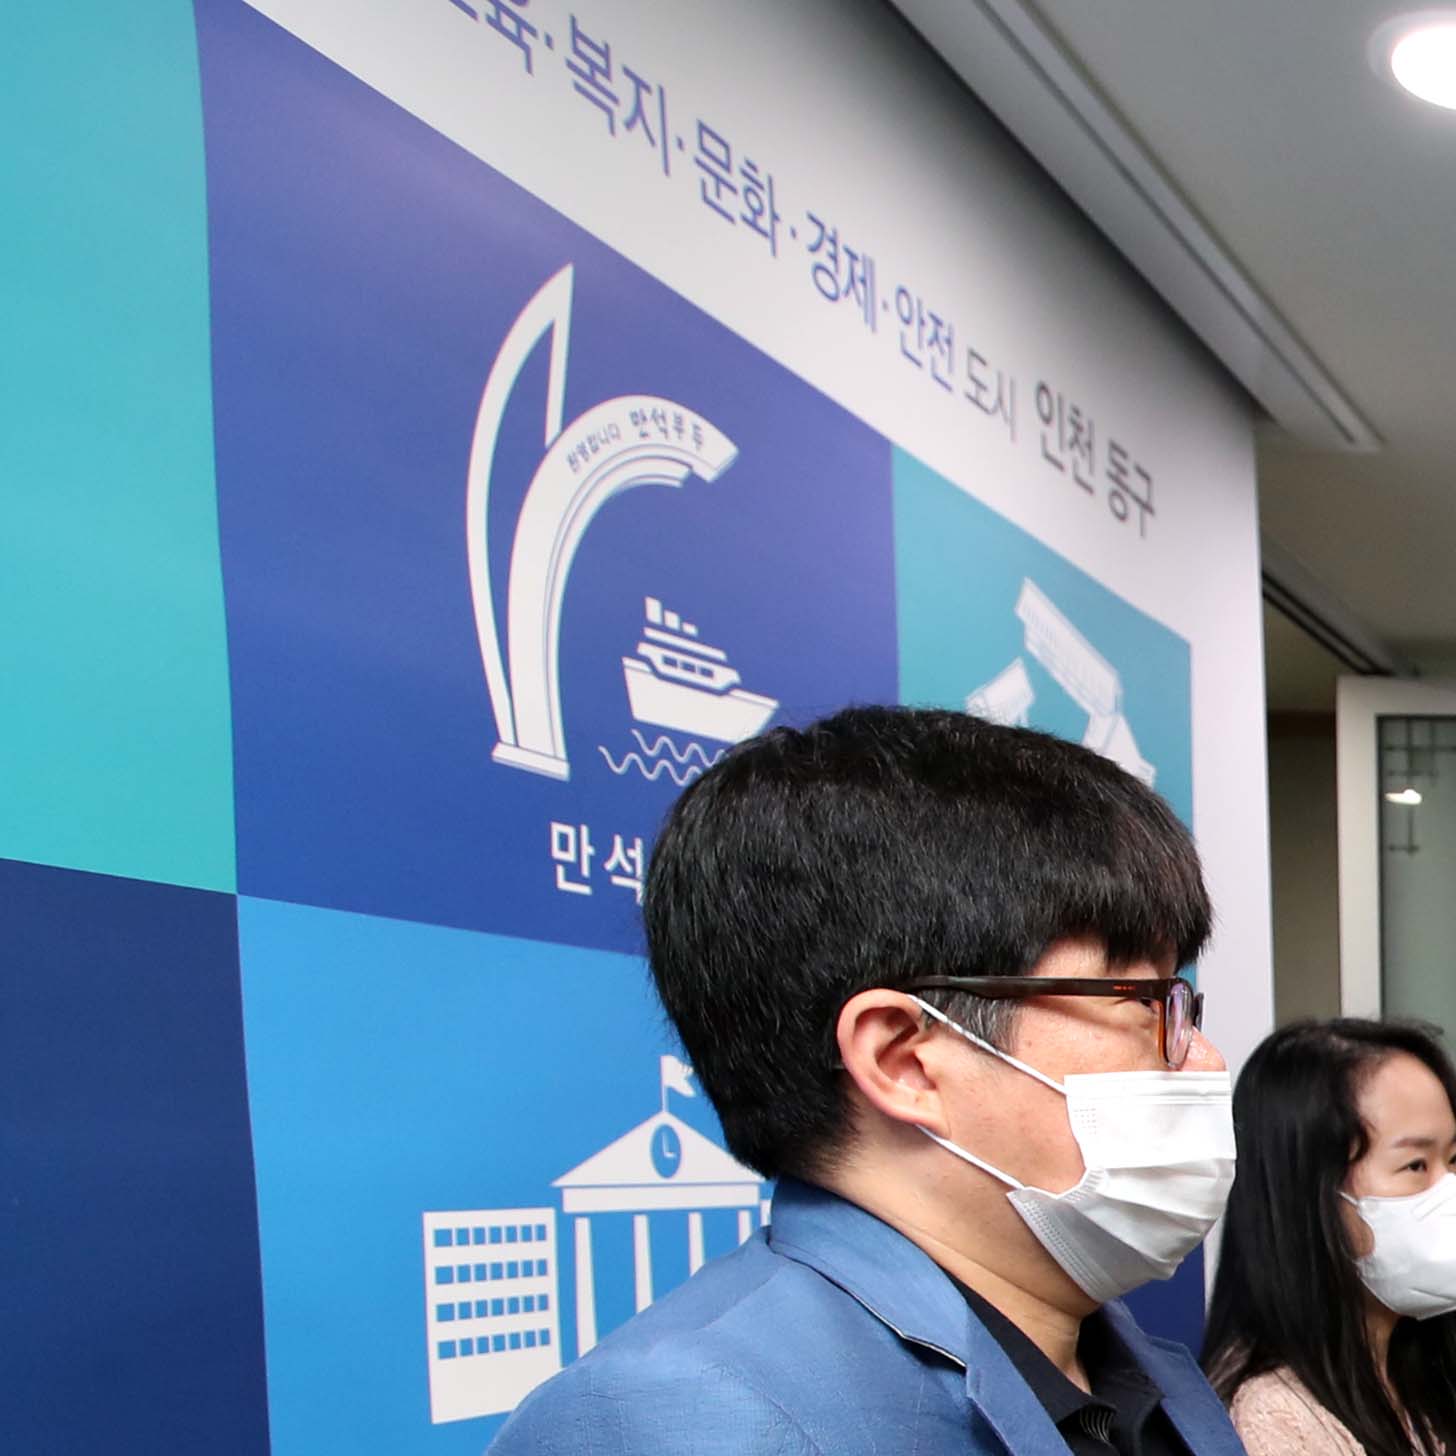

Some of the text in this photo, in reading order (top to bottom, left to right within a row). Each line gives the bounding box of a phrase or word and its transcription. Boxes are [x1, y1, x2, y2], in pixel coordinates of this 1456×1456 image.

[965, 346, 1015, 443] 도시
[1036, 380, 1095, 496] 인천
[1106, 437, 1156, 539] 동구
[549, 820, 645, 907] 만석
